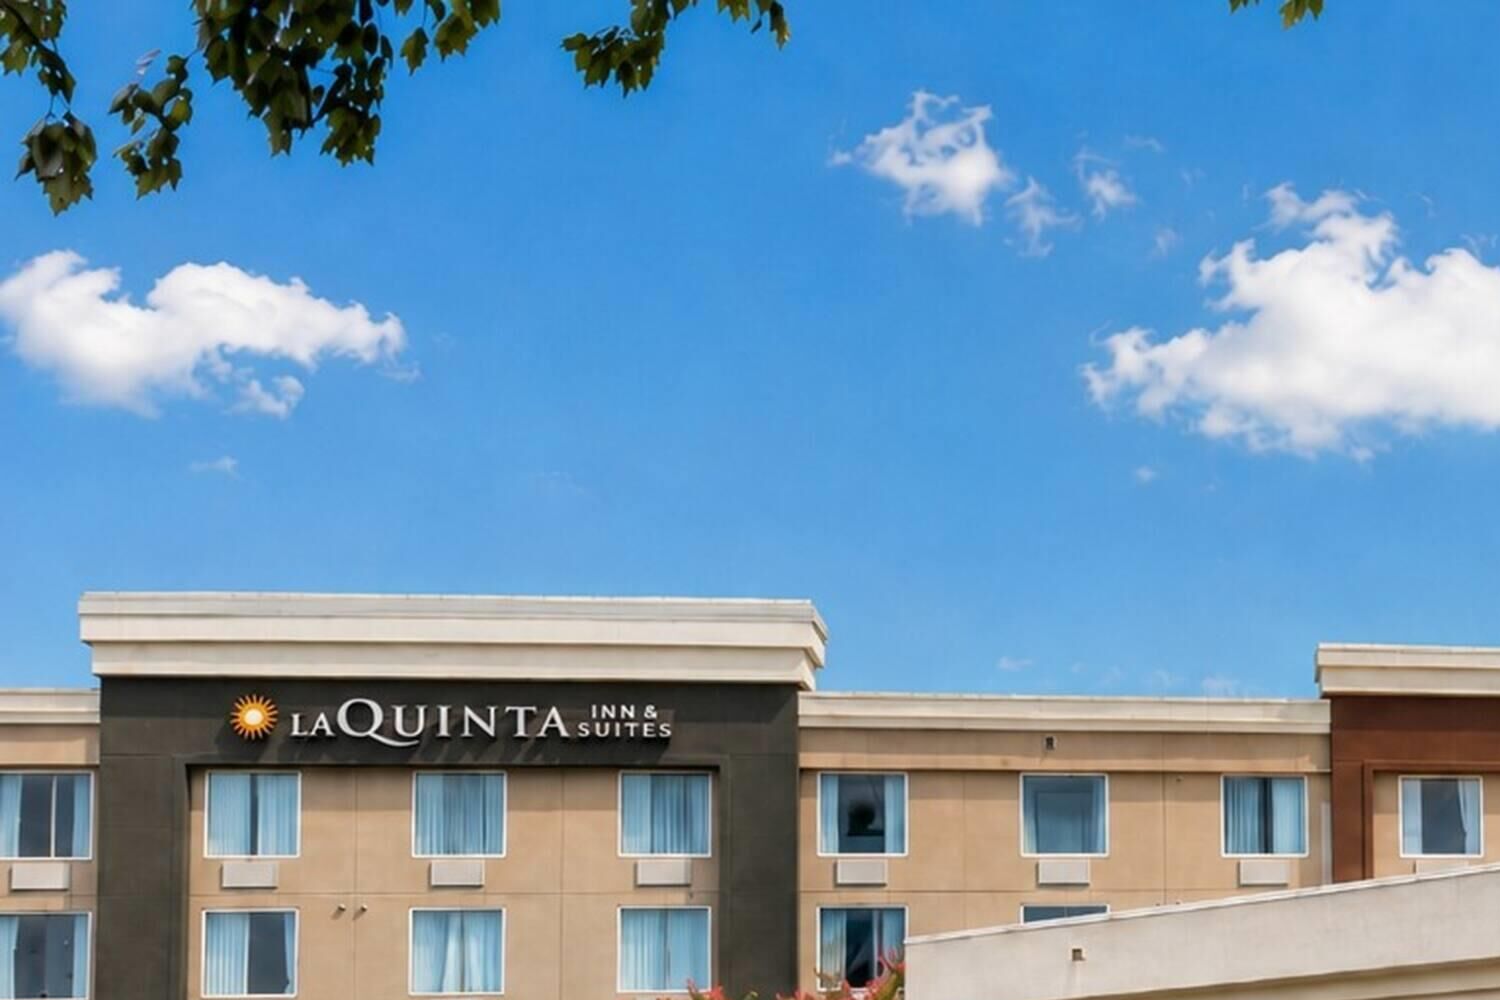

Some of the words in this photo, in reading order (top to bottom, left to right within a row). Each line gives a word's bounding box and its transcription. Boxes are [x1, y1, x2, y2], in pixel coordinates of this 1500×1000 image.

[591, 704, 635, 719] INN
[643, 704, 657, 719] &
[577, 722, 672, 737] SUITES
